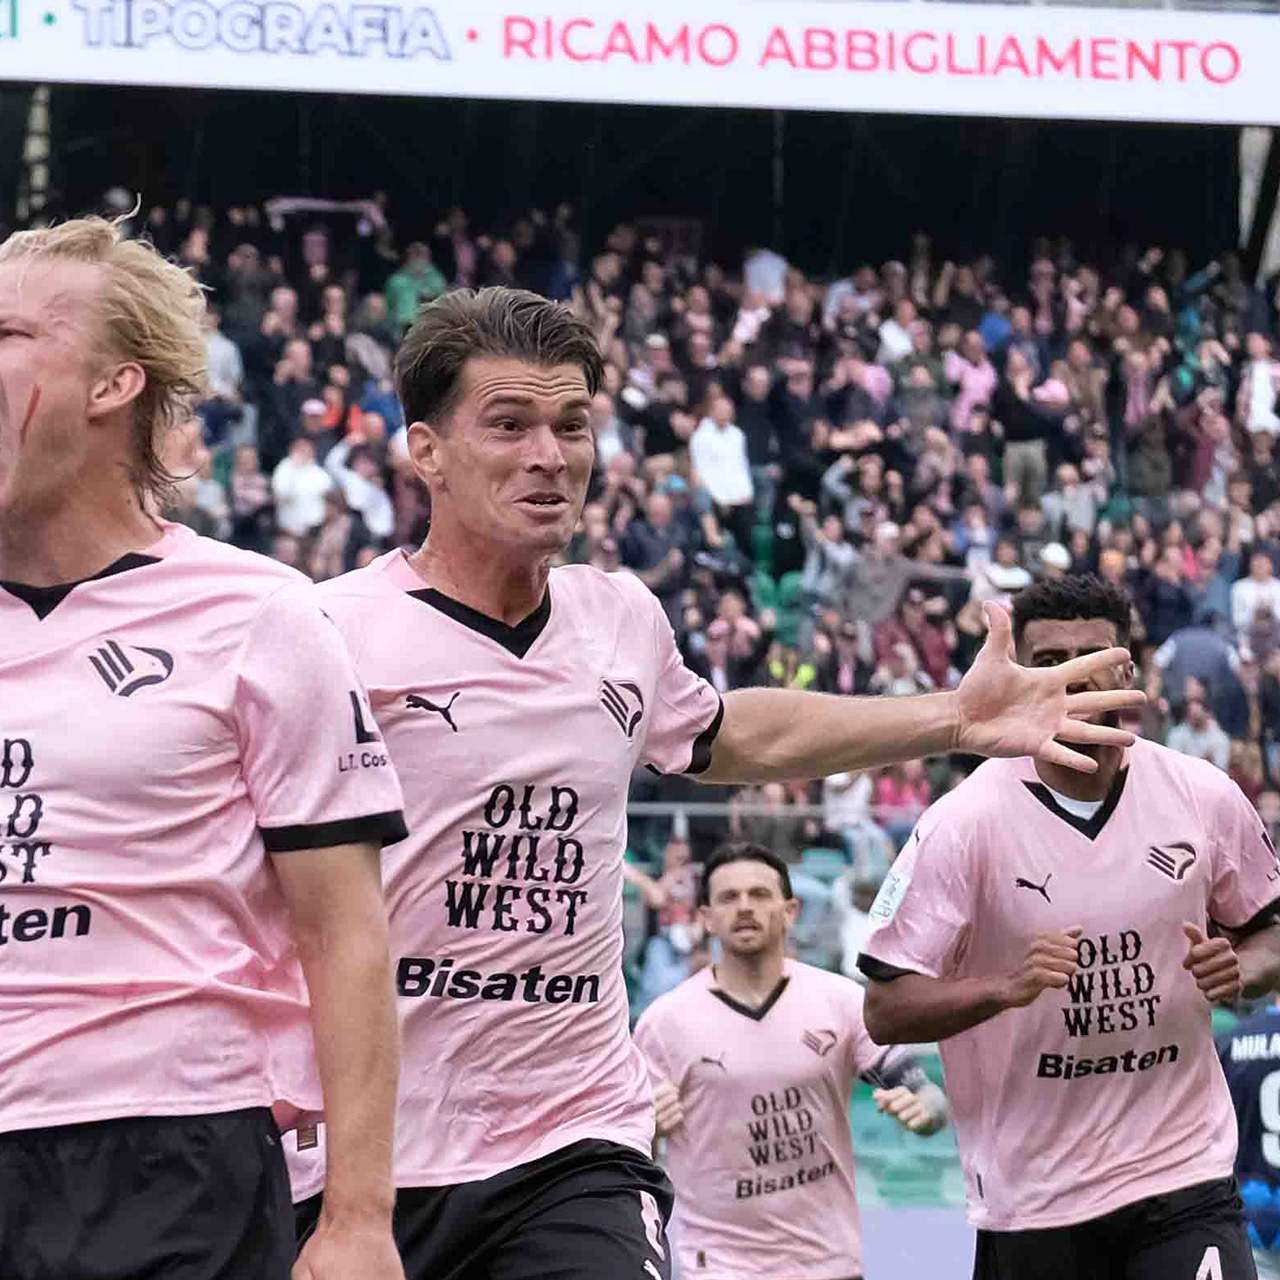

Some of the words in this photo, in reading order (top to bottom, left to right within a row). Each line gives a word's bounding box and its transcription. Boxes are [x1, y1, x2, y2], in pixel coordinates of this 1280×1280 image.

[81, 2, 451, 60] TIPOGRAFIA
[502, 15, 739, 67] RICAMO
[758, 28, 1241, 84] ABBIGLIAMENTO
[484, 784, 580, 832] OLD
[461, 830, 585, 885] WILD
[445, 879, 587, 936] WEST
[1077, 929, 1142, 969] OLD
[396, 957, 600, 1004] Bisaten
[1067, 962, 1155, 1003] WILD
[1062, 995, 1160, 1037] WEST
[1037, 1044, 1179, 1080] Bisaten
[751, 1086, 802, 1117] OLD
[748, 1109, 813, 1143] WILD
[749, 1132, 818, 1167] WEST
[735, 1161, 836, 1200] Bisaten
